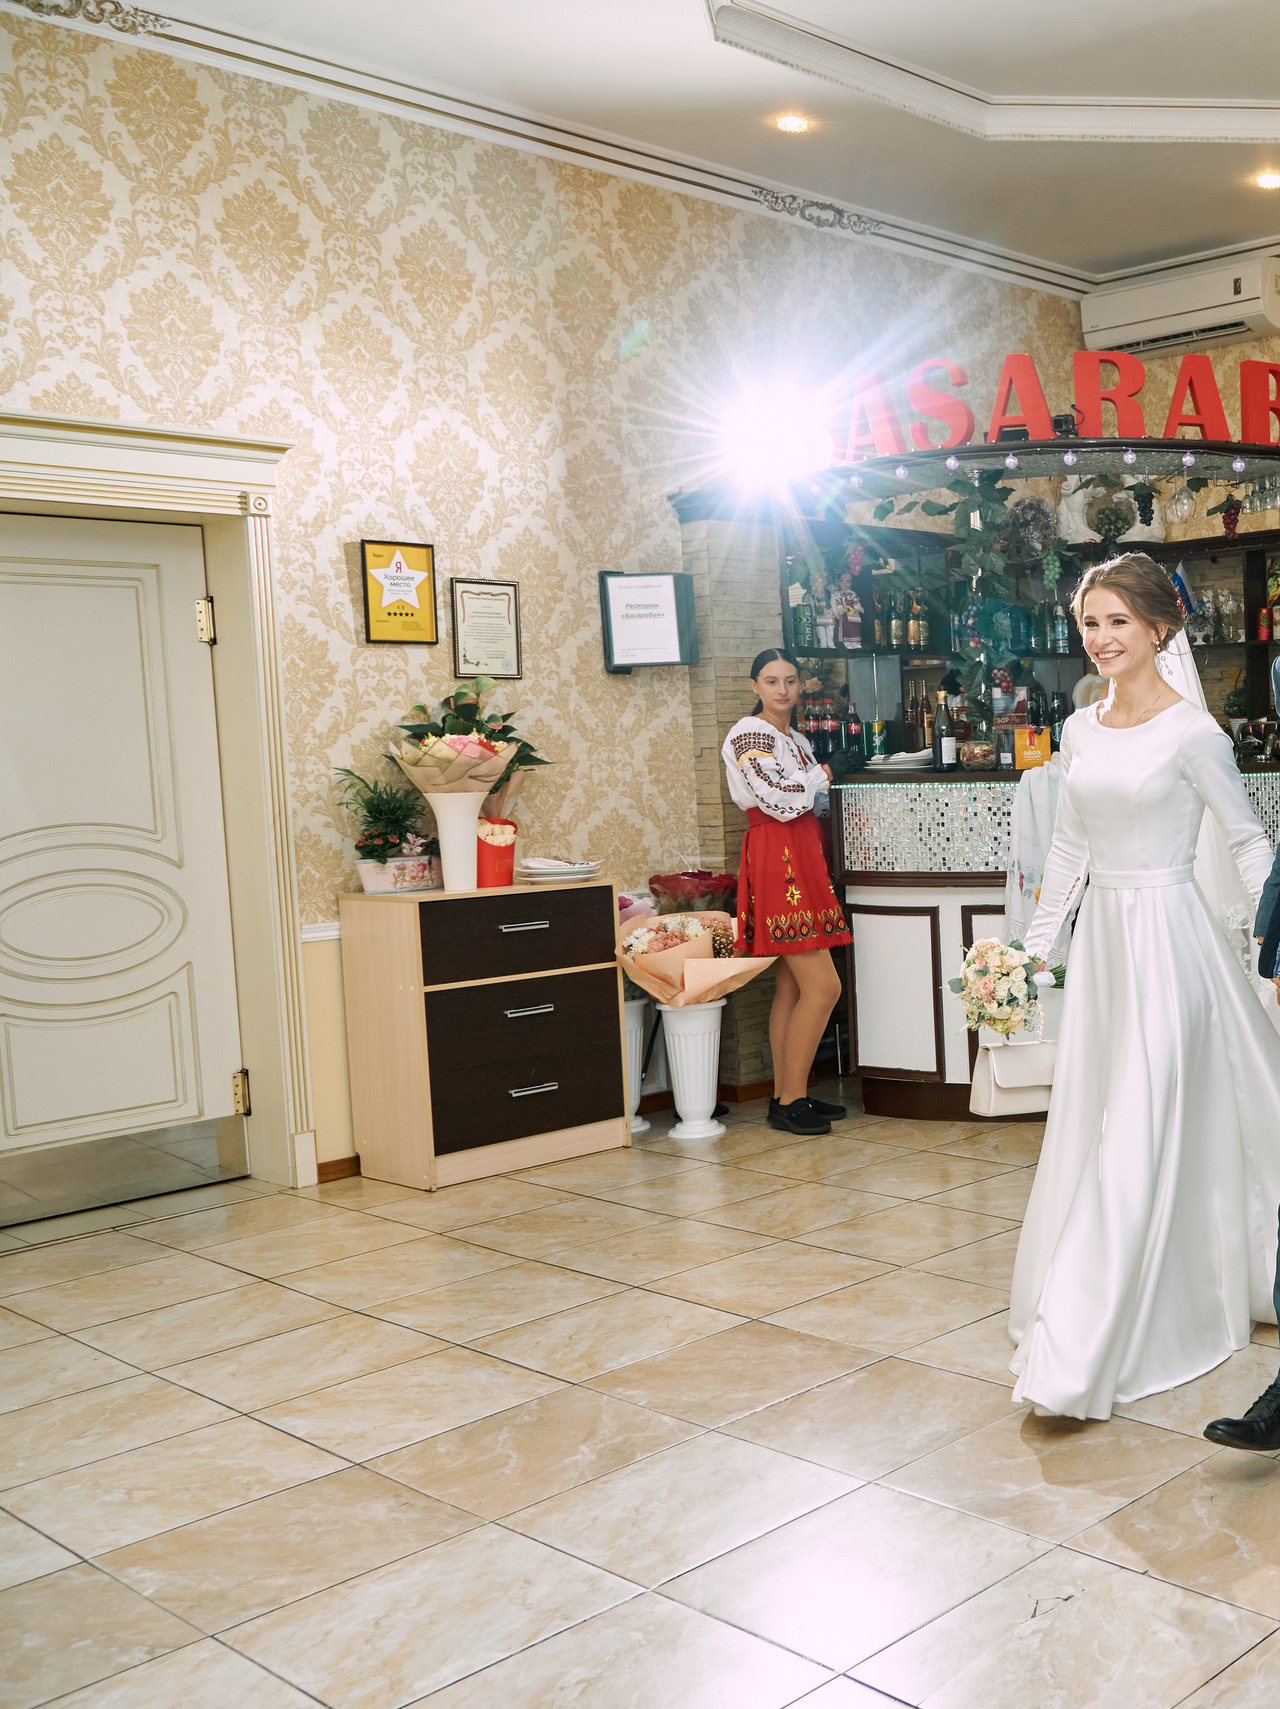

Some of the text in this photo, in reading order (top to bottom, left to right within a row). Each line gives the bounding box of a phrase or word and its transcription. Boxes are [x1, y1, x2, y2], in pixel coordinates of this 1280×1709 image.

[395, 561, 402, 573] Я
[384, 573, 415, 582] Хорошее
[621, 611, 665, 619] «Басарабия»
